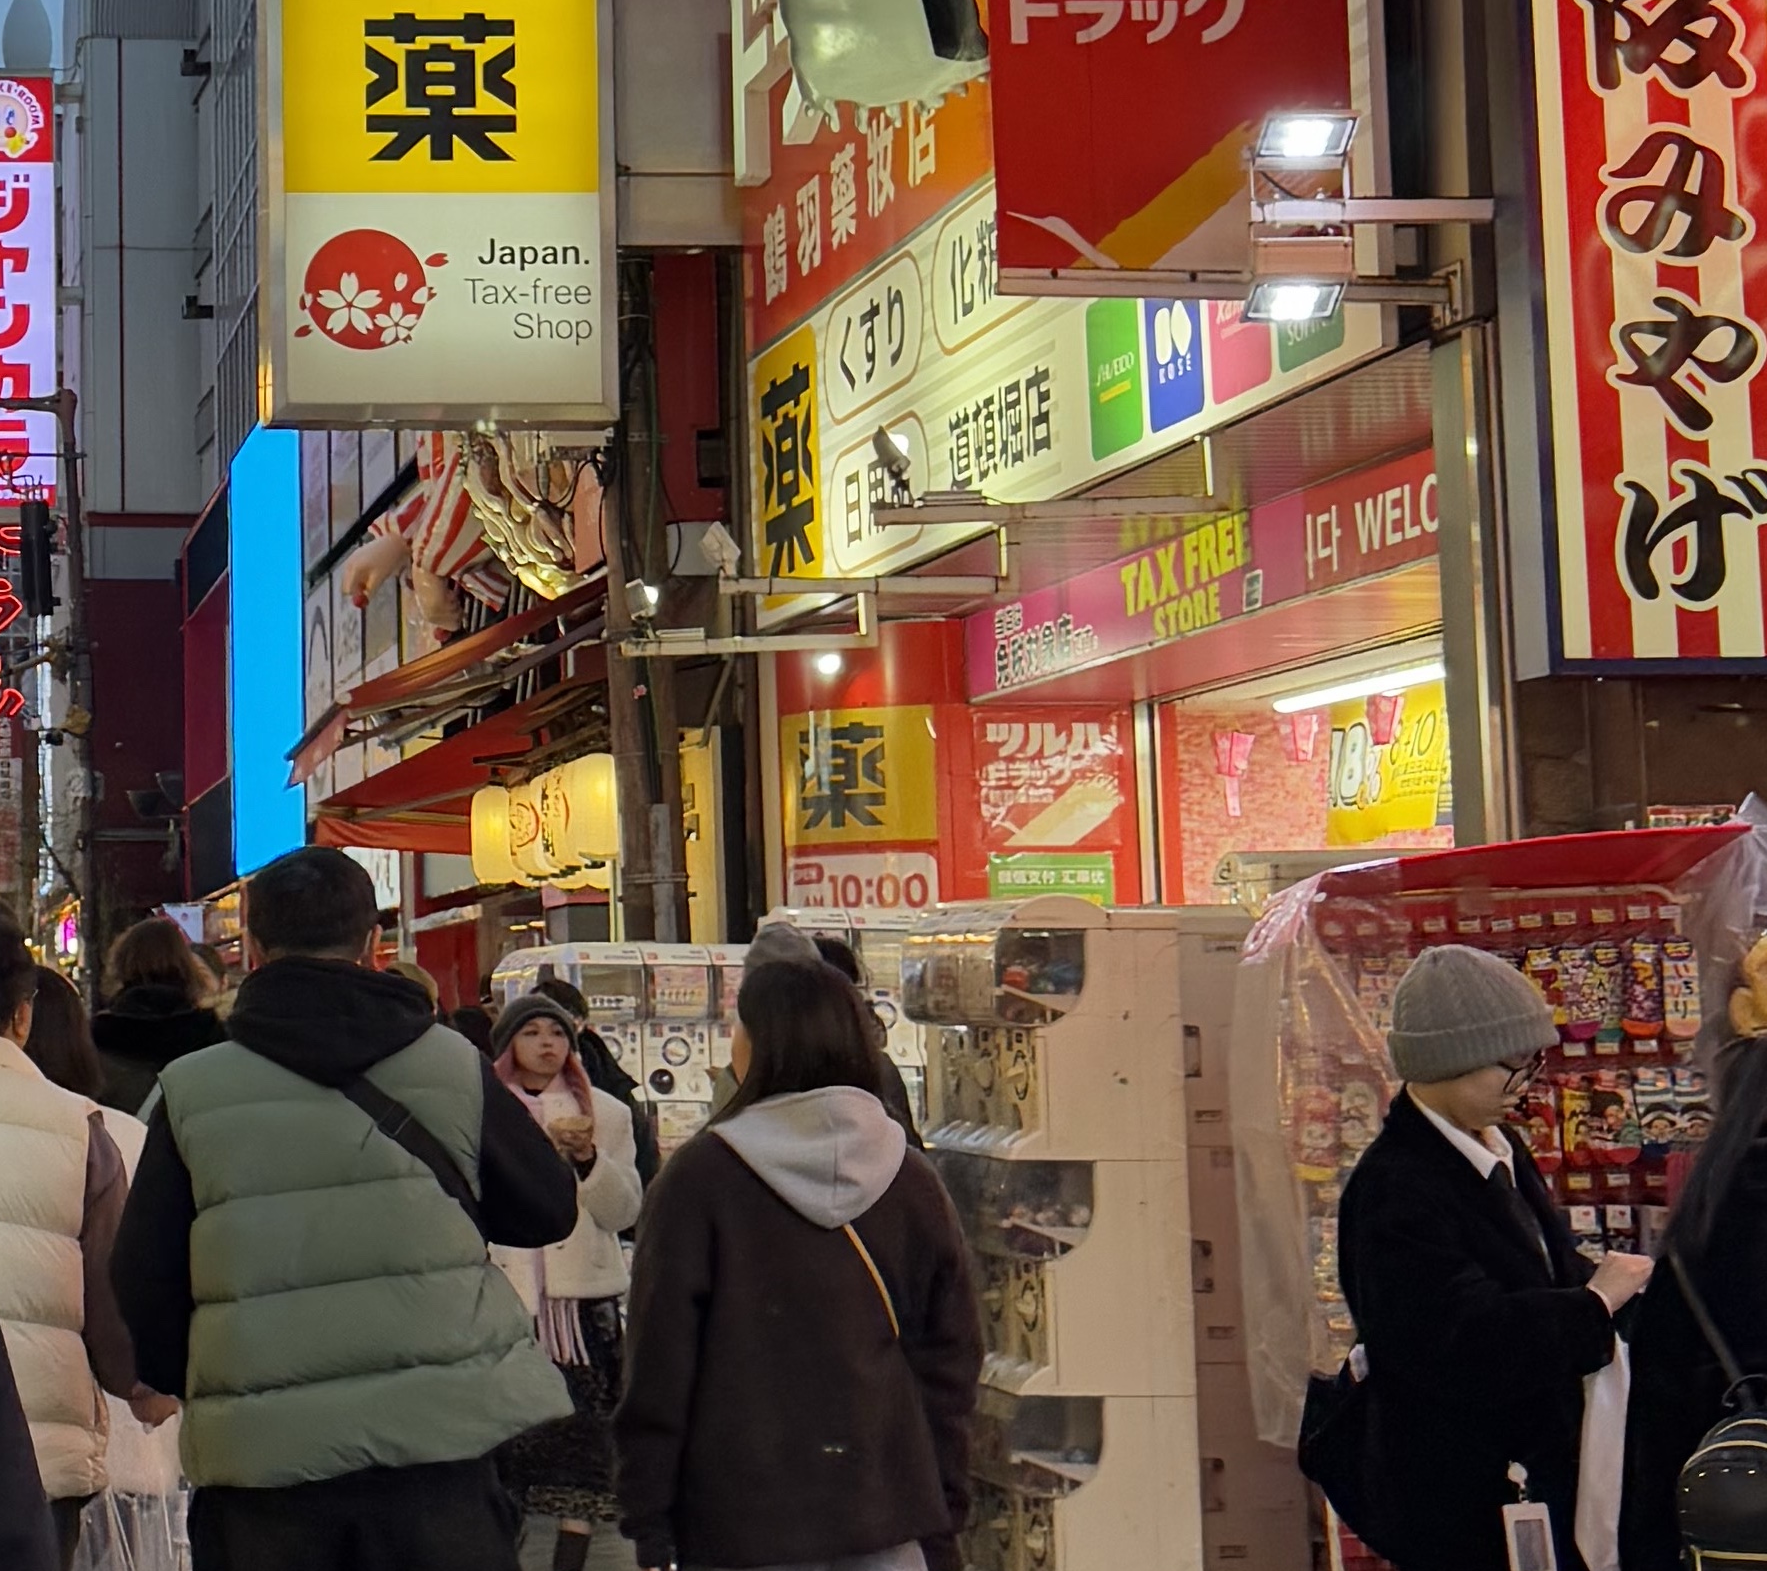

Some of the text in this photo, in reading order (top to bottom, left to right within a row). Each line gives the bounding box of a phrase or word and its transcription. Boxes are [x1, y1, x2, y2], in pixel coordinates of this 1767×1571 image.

[364, 12, 518, 162] 薬
[465, 277, 592, 306] Tax-free
[478, 237, 591, 272] Japan.
[512, 313, 593, 346] Shop
[839, 285, 906, 393] くすり
[760, 361, 815, 579] 薬
[949, 365, 1052, 492] 道頓堀店
[1120, 540, 1180, 618] TAX
[1183, 510, 1250, 591] FREE
[1153, 581, 1221, 640] STORE
[798, 721, 887, 830] 薬
[986, 722, 1104, 759] ツルハ
[828, 872, 929, 909] 10:00
